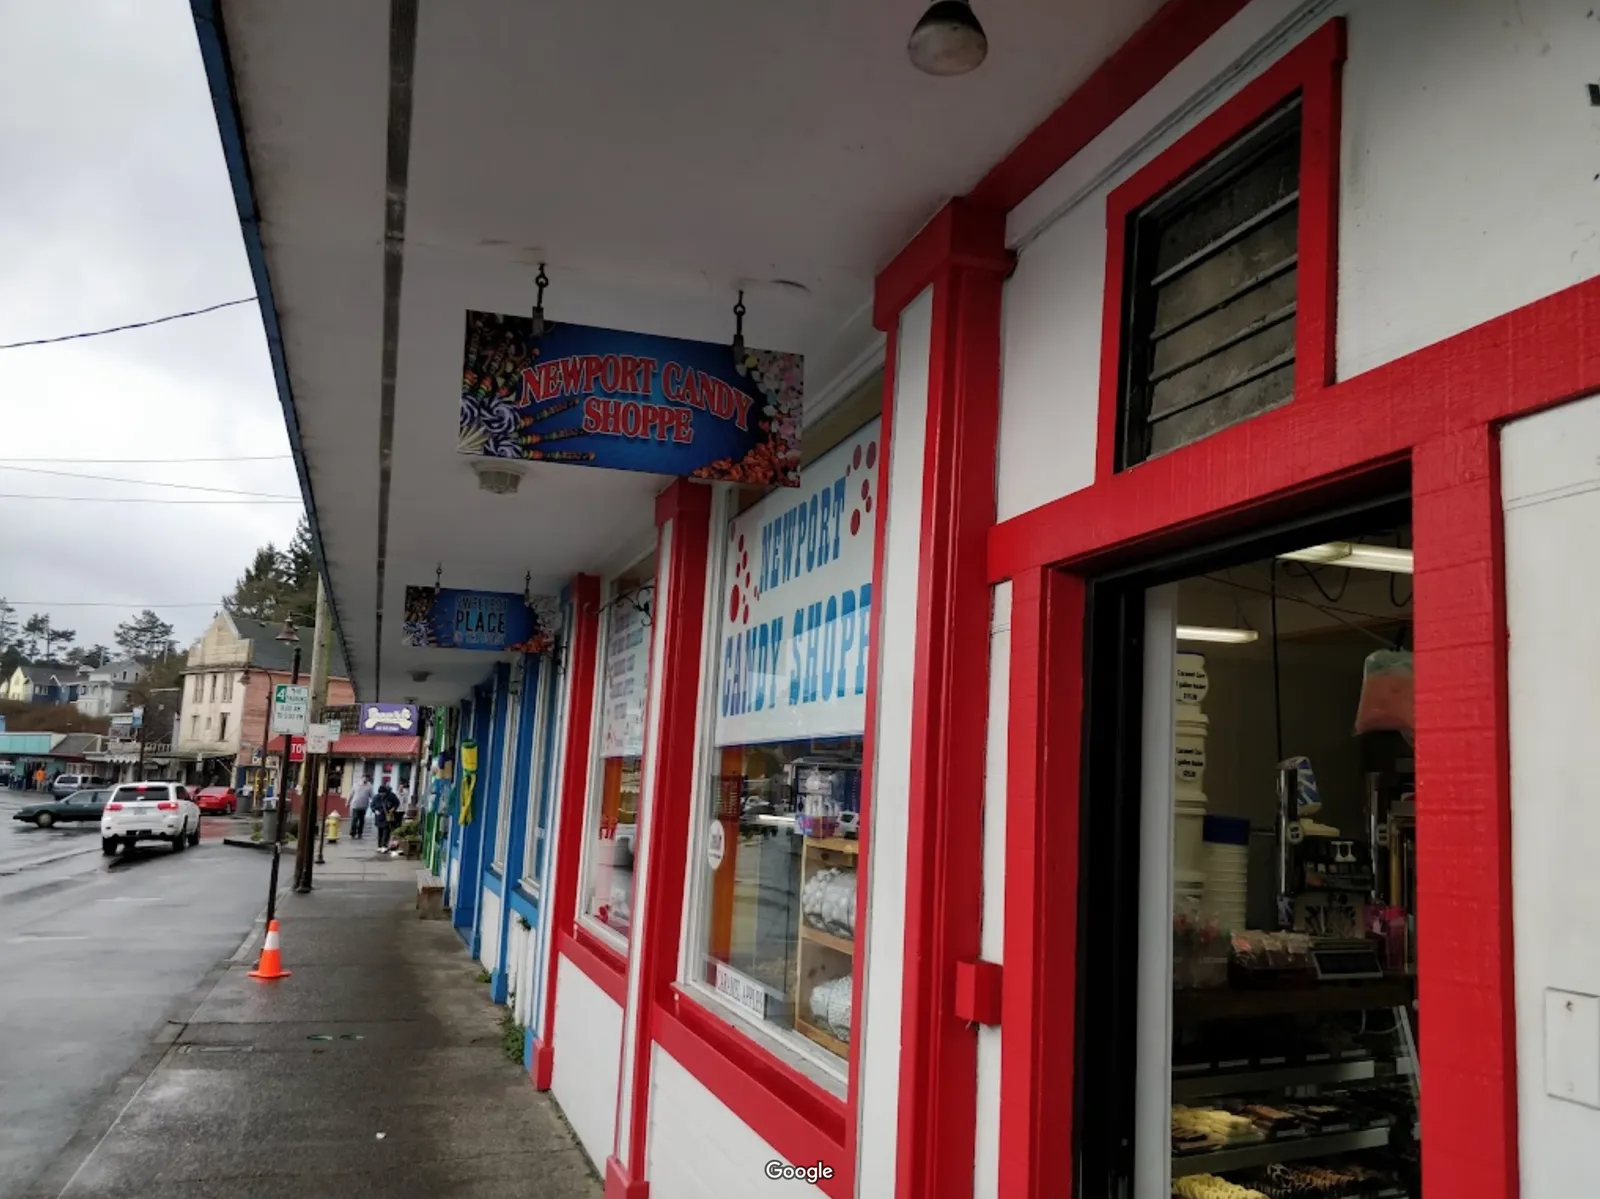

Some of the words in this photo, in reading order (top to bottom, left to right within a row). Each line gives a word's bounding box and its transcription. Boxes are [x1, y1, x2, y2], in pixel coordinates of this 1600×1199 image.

[519, 355, 657, 408] NEWPORT
[660, 361, 754, 431] CANDY
[582, 396, 694, 443] SHOPPE
[759, 476, 847, 594] NEWPORT
[455, 610, 505, 634] PLACE
[277, 688, 286, 700] 4
[721, 616, 784, 718] CANDY
